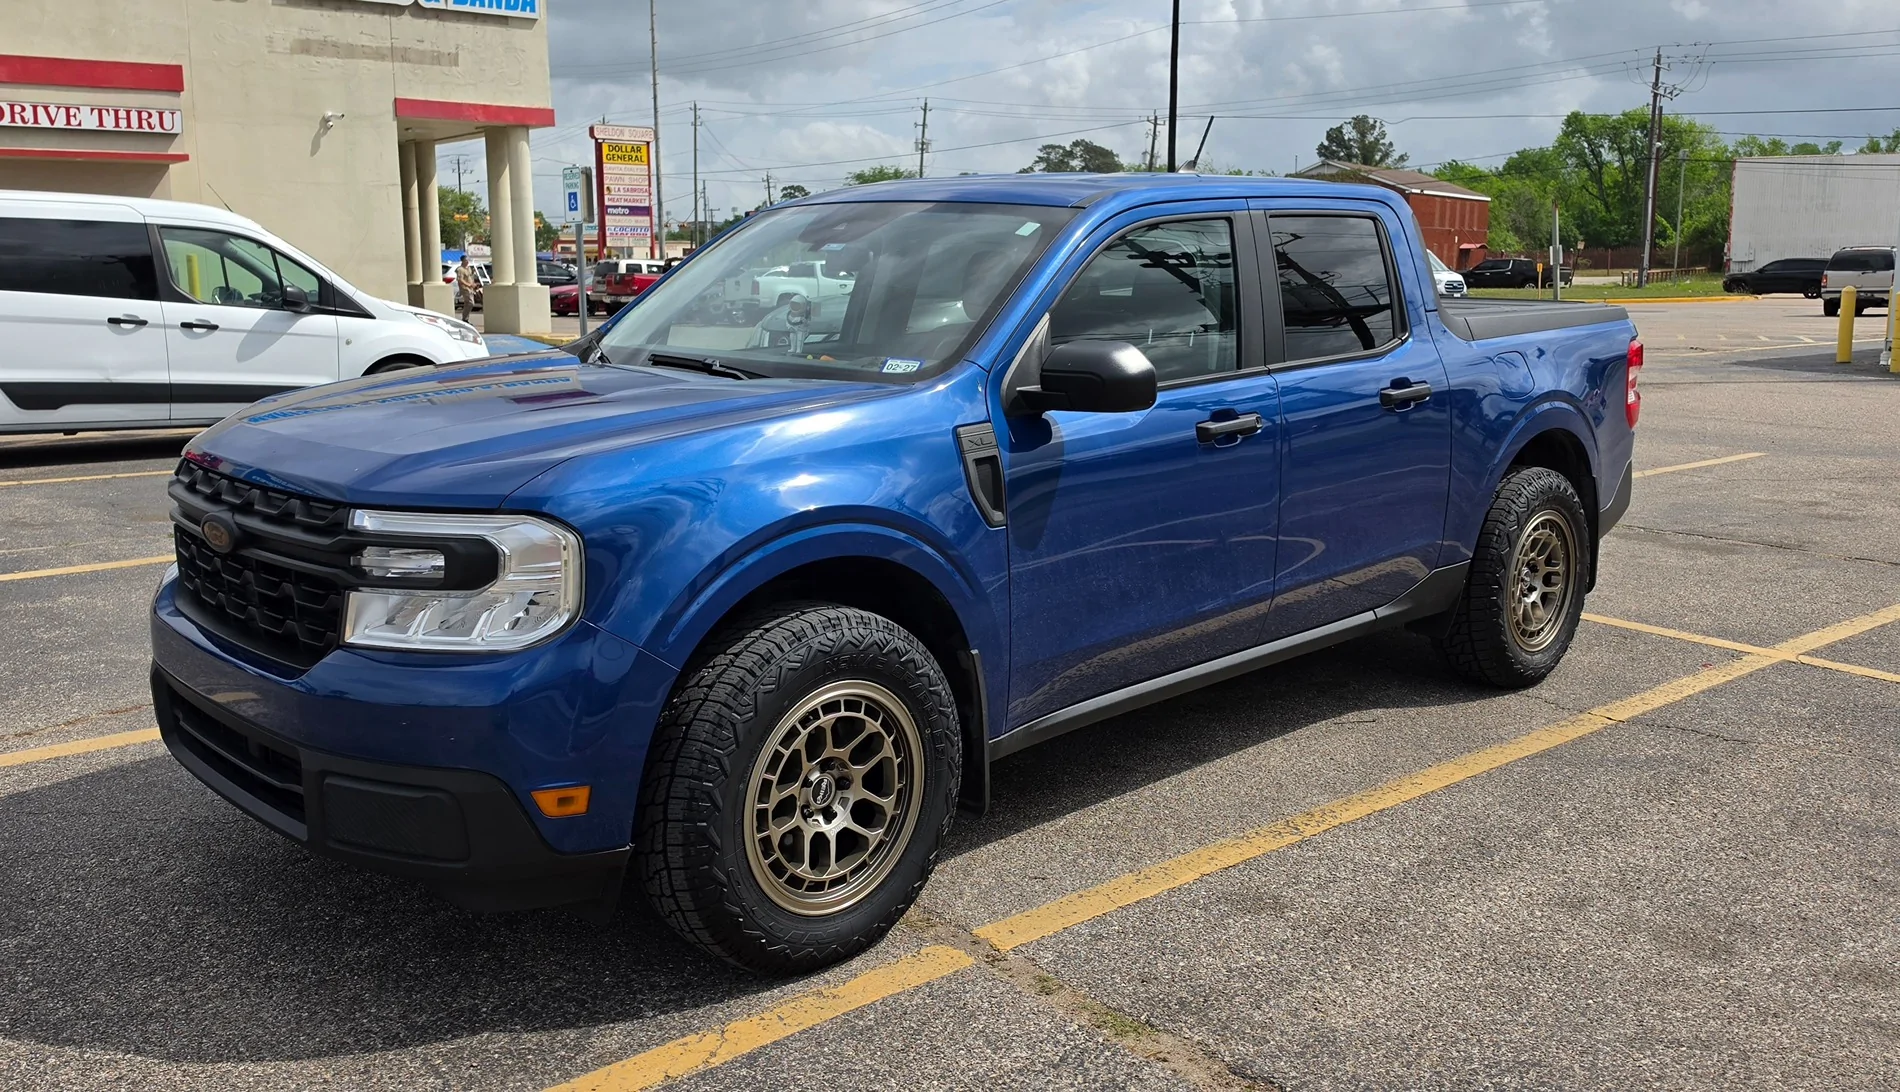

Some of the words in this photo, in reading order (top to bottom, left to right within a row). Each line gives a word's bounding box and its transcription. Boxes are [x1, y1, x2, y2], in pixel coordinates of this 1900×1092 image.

[0, 103, 82, 127] RIVE
[90, 108, 176, 132] THRU
[596, 127, 625, 137] SHELDON
[628, 129, 653, 140] SQUARE
[608, 145, 642, 154] DOLLAR
[606, 154, 645, 162] GENERAL
[604, 175, 625, 183] PAWN
[607, 207, 629, 215] metro
[967, 437, 993, 449] XL
